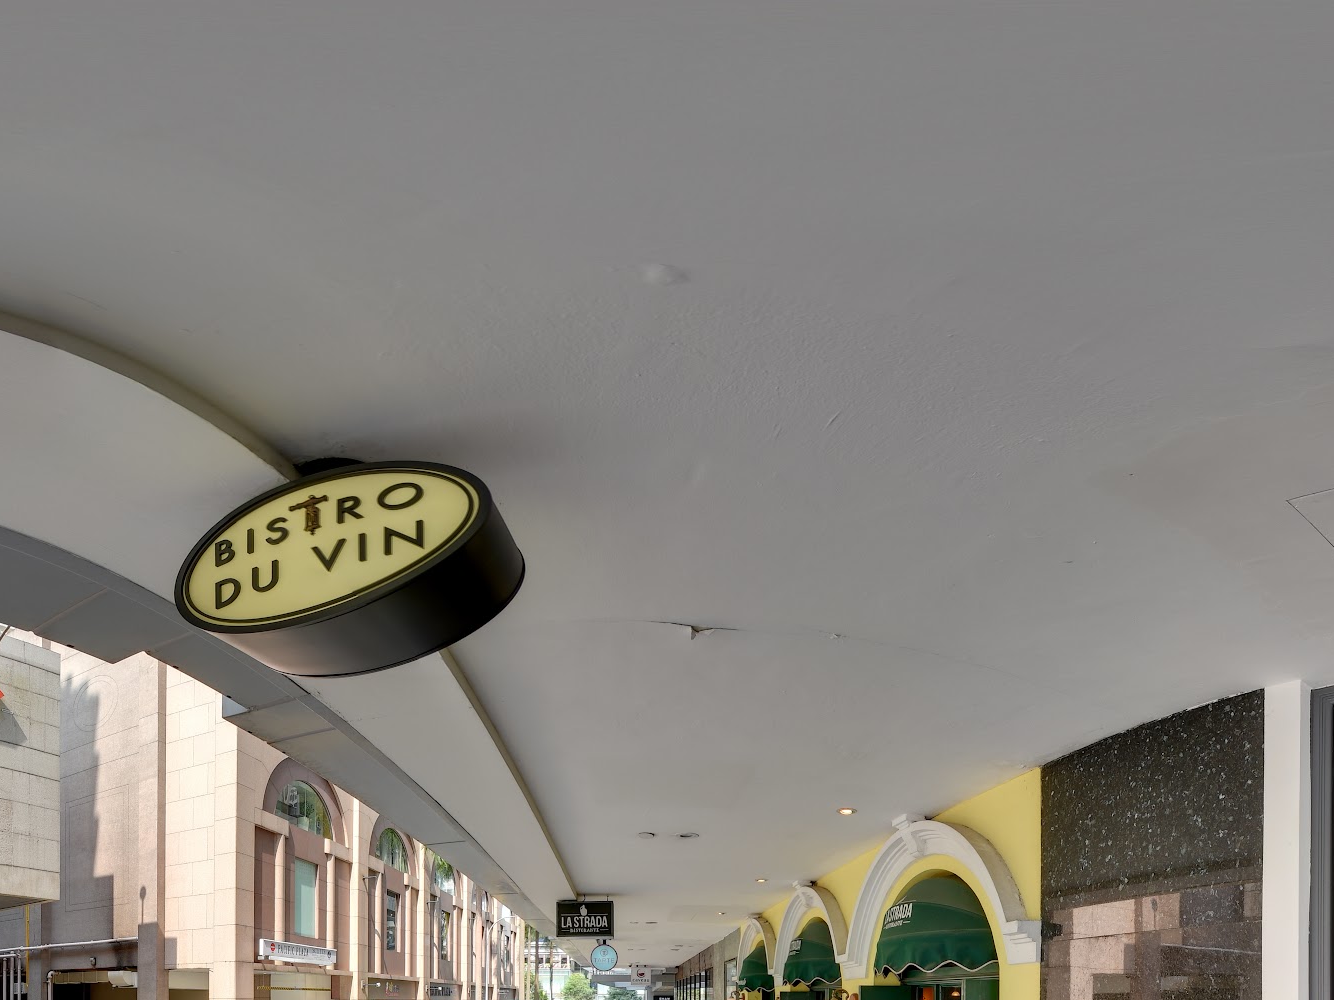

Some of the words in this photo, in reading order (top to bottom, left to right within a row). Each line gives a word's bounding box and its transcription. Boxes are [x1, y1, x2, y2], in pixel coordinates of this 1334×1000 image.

[214, 481, 424, 568] BISTRO
[214, 559, 280, 610] DU
[310, 519, 425, 573] VIN
[561, 916, 572, 928] LA
[573, 916, 608, 928] STRADA
